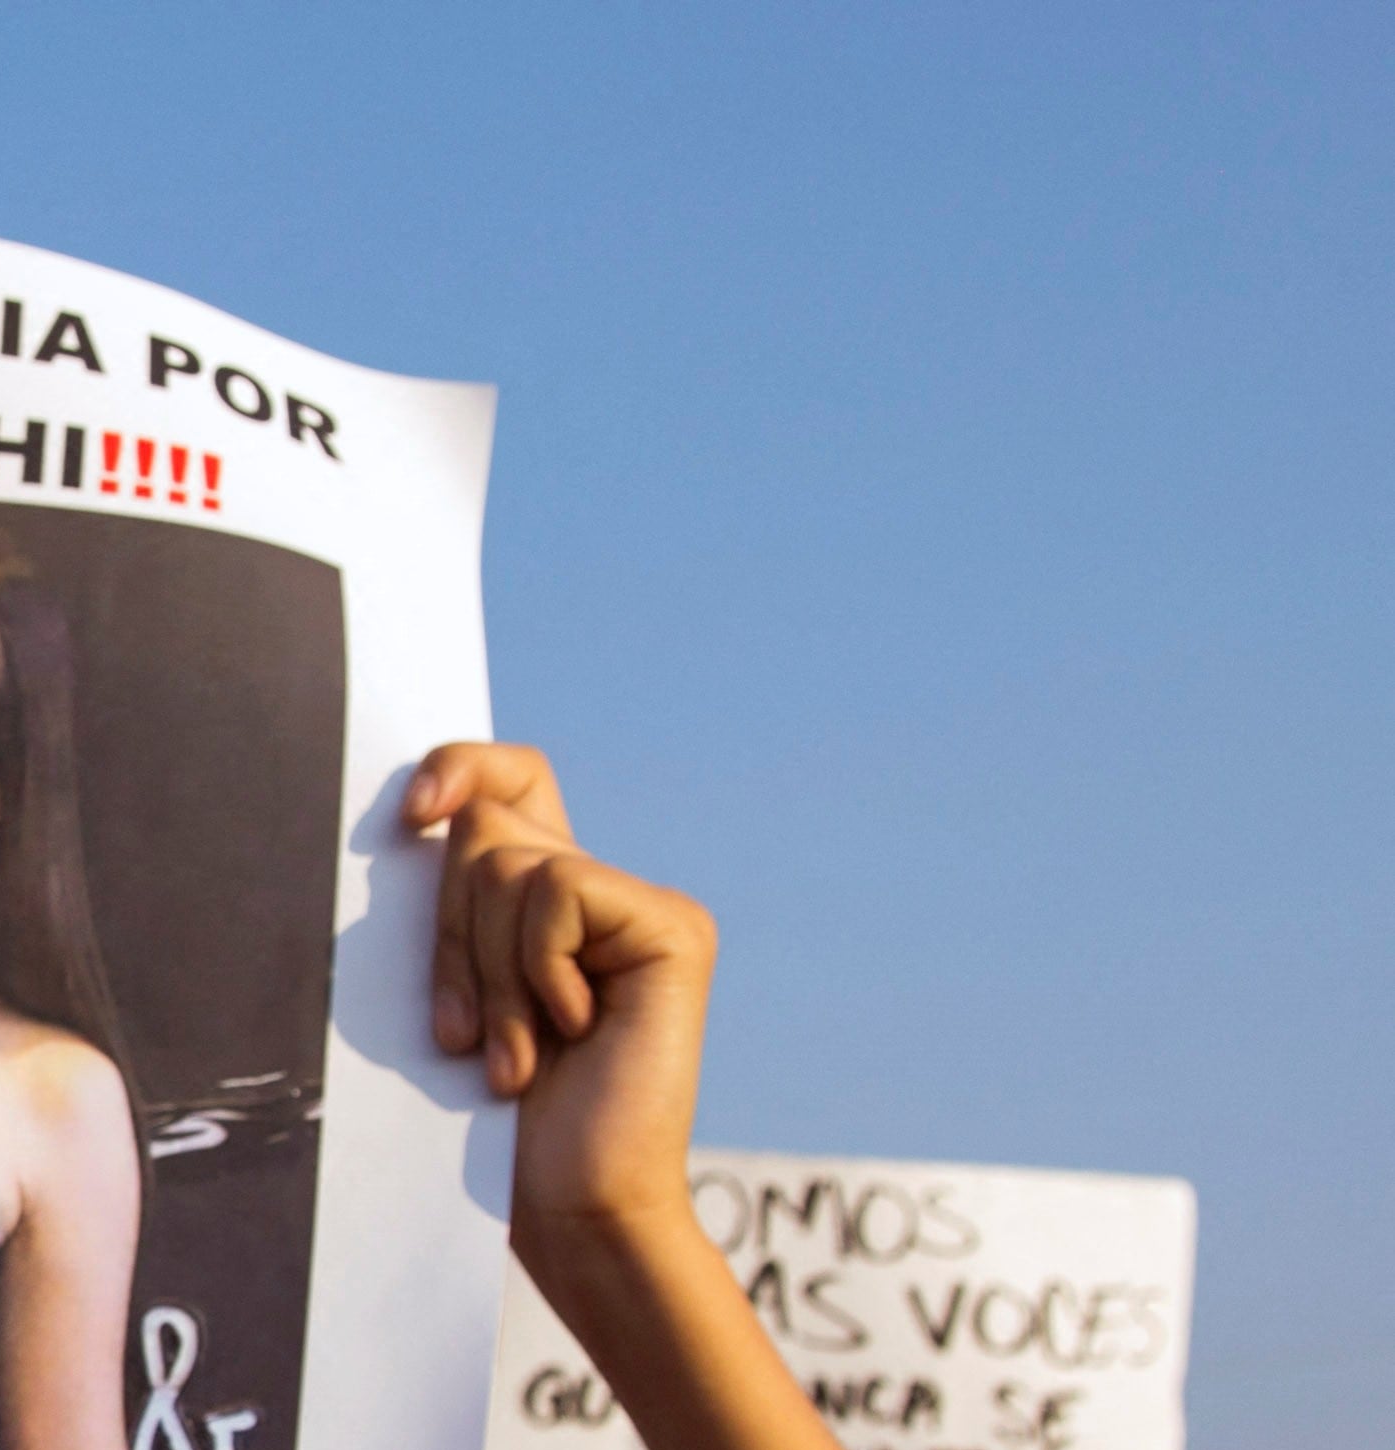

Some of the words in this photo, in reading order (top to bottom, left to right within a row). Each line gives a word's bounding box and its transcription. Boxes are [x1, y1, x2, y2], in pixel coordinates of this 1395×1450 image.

[149, 335, 342, 462] POR
[693, 1168, 979, 1263] OMOS
[749, 1262, 867, 1352] AS
[907, 1275, 1169, 1370] VOCES
